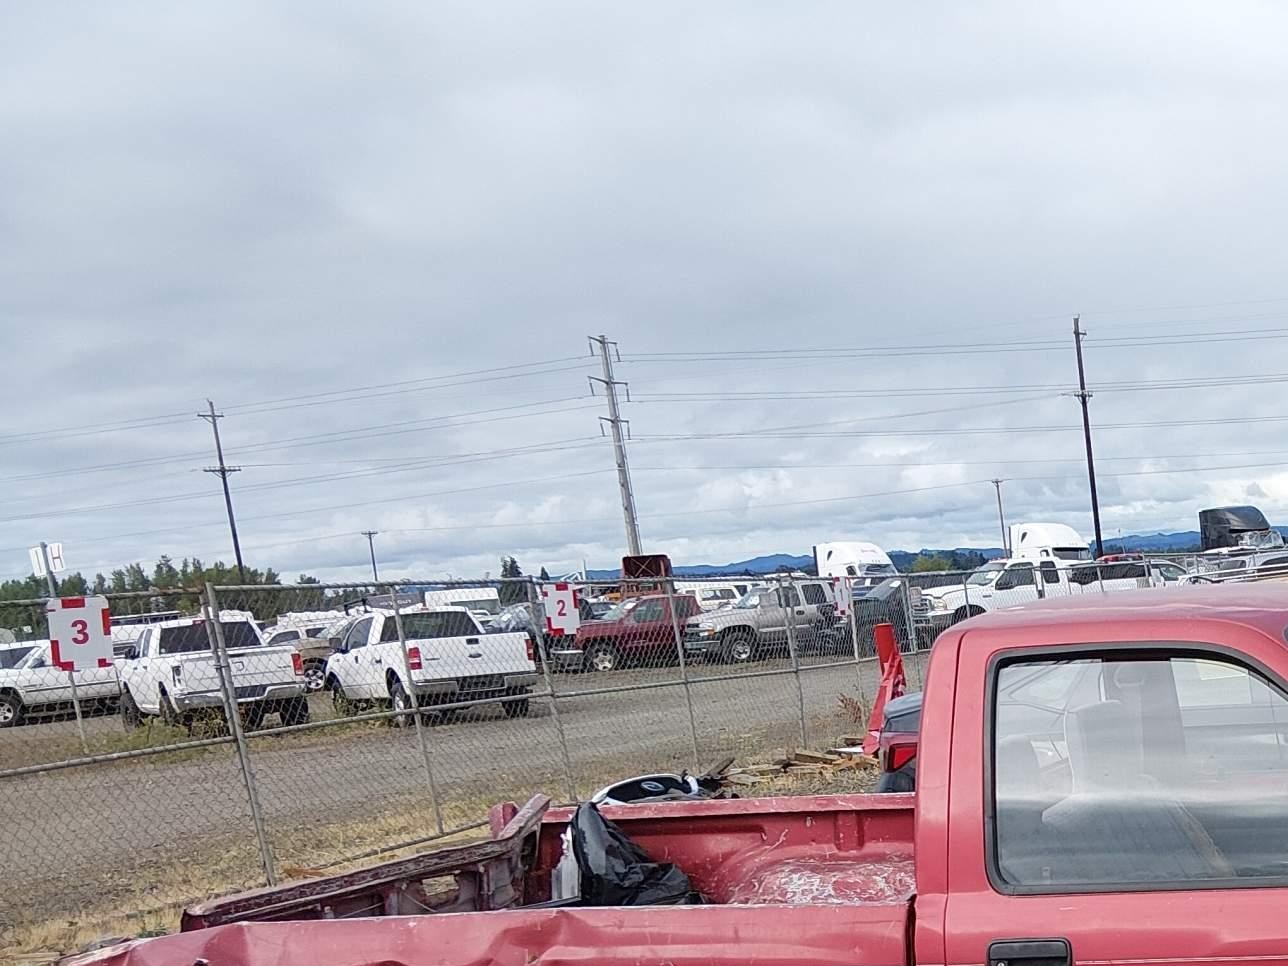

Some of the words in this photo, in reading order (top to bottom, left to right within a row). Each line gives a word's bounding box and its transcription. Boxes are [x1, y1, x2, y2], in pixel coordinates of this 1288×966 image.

[50, 544, 64, 570] H
[556, 599, 567, 617] 2
[71, 619, 89, 645] 3
